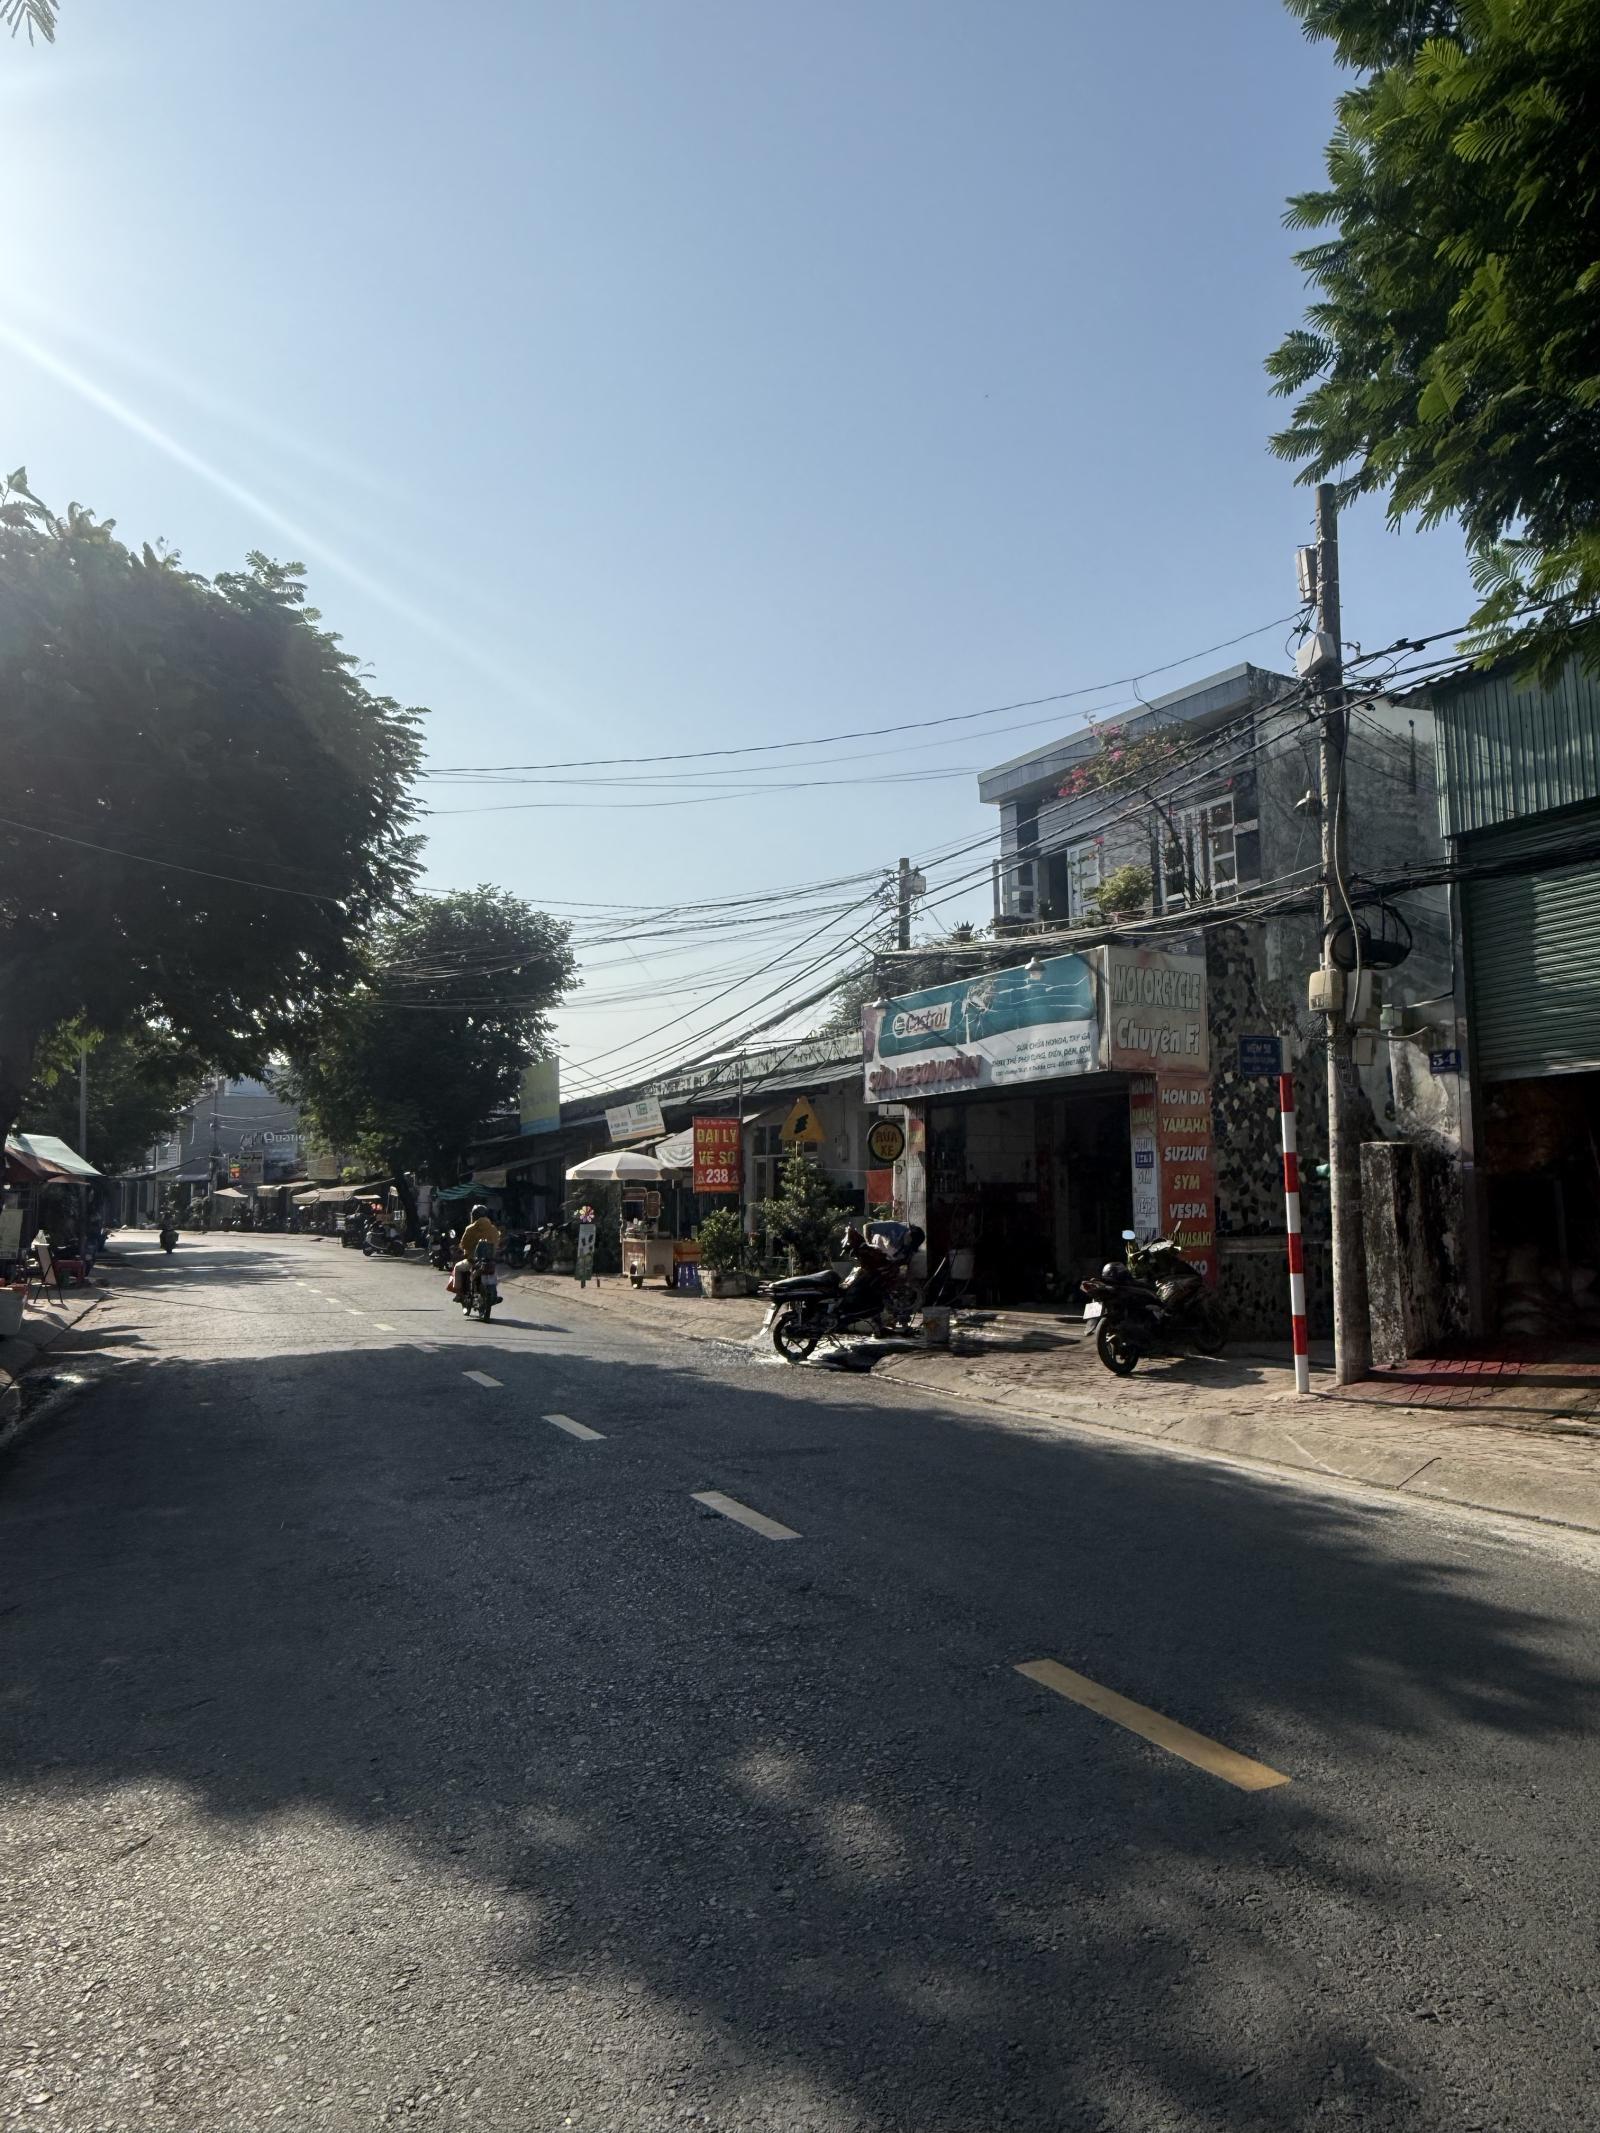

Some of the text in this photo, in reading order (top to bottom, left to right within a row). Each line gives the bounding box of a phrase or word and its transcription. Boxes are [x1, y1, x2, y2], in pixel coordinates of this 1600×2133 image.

[1113, 964, 1200, 1009] MOTORCYCLE
[905, 1009, 947, 1033] Castrol
[1433, 1052, 1456, 1066] 54
[1162, 1118, 1207, 1133] YAMAHA
[880, 1145, 894, 1156] XE
[1164, 1146, 1207, 1162] SUZUKI
[706, 1169, 729, 1184] 238
[1174, 1174, 1200, 1190] SYM
[1169, 1203, 1207, 1219] VESPA
